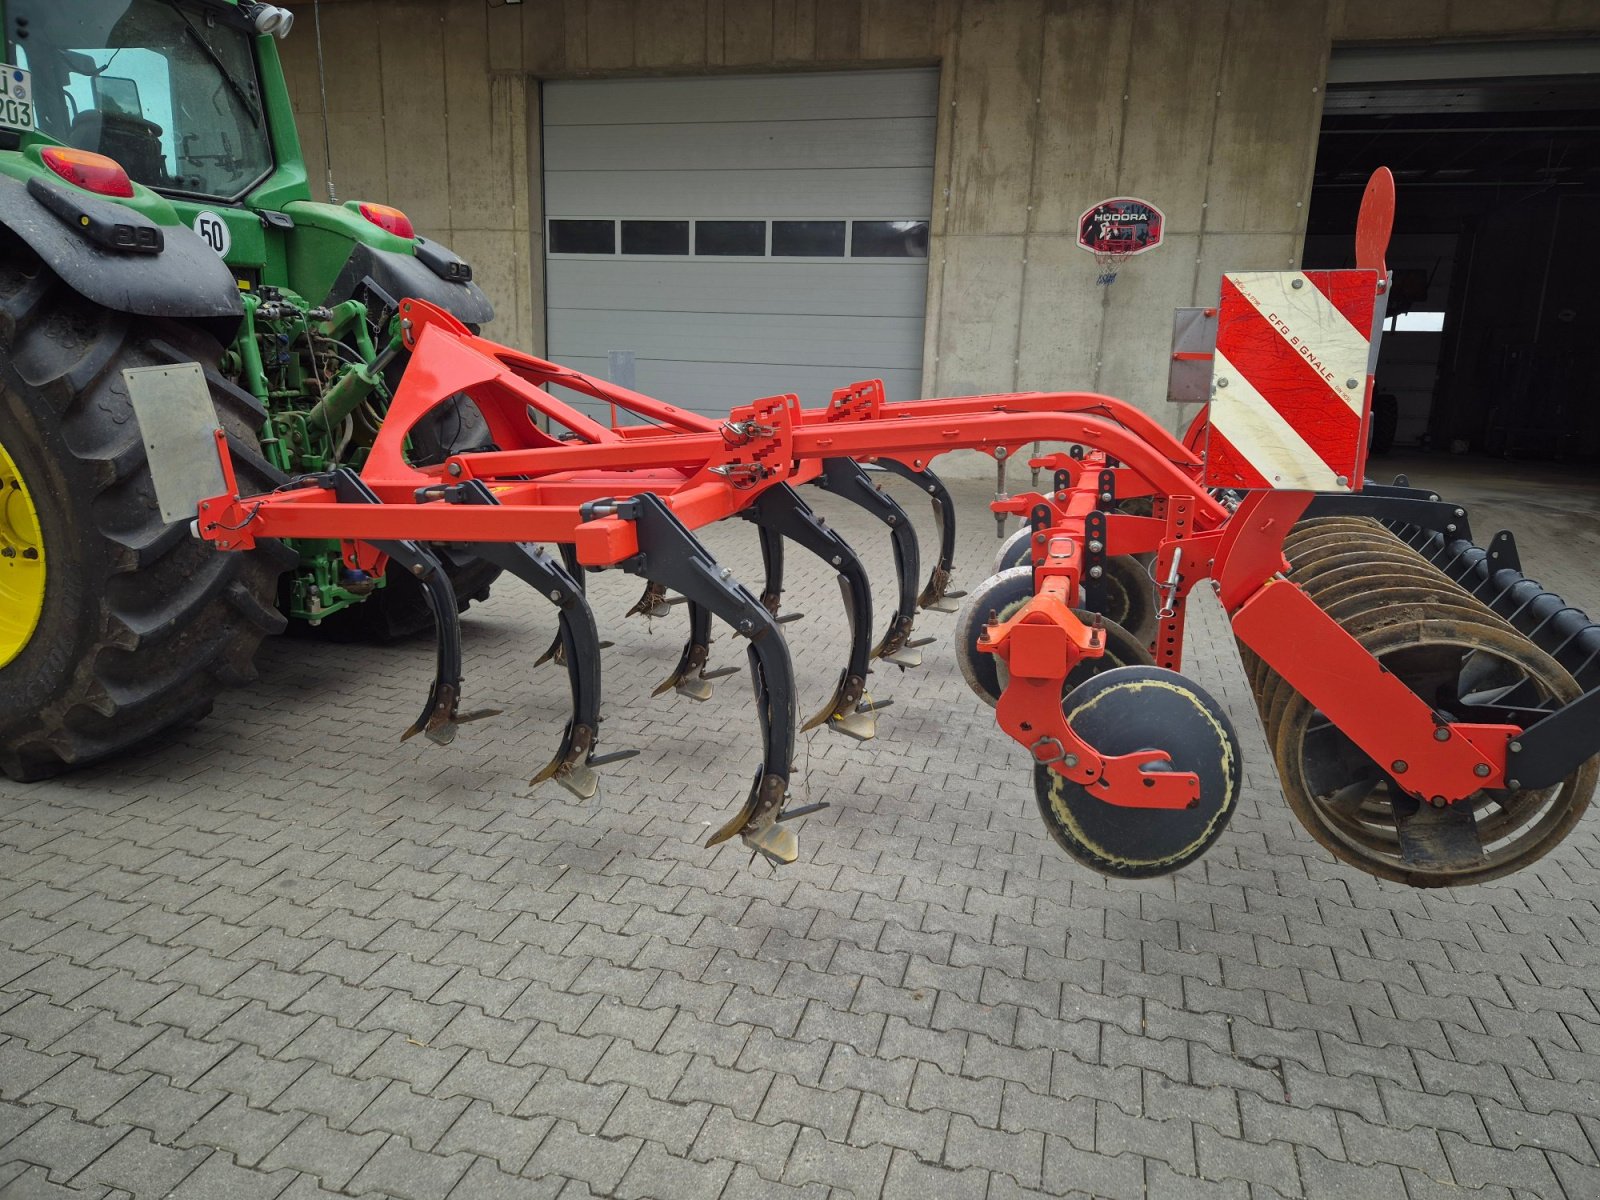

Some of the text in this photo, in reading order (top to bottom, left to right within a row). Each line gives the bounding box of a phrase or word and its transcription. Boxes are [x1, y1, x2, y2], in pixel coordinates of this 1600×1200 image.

[200, 218, 223, 251] 50
[1268, 313, 1335, 382] CFG SGNALE
